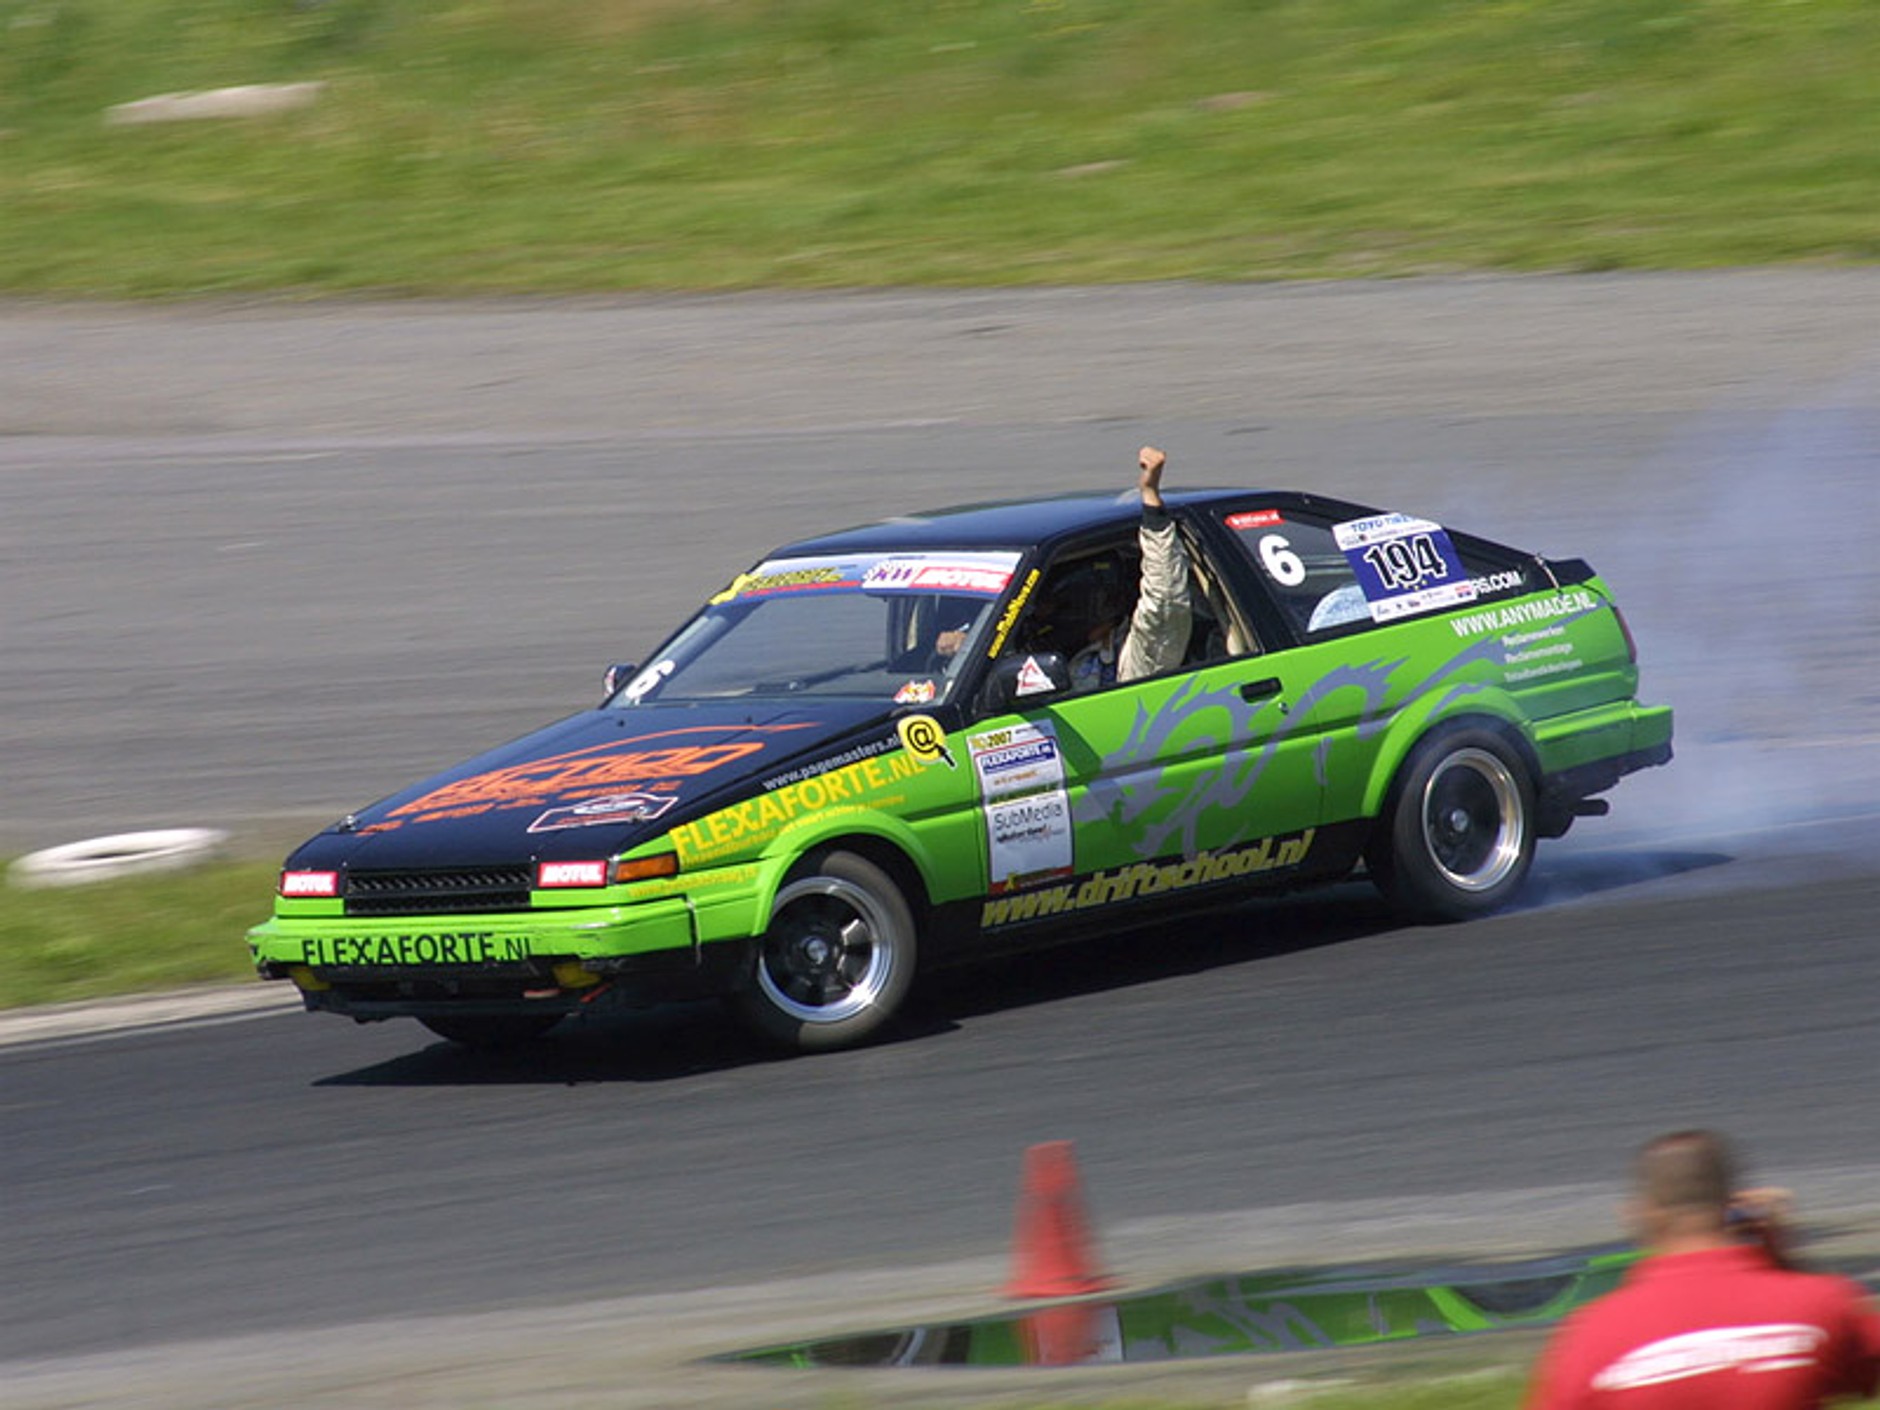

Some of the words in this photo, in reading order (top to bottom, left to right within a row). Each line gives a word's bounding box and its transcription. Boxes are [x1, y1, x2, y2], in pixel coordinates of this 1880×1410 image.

[1259, 534, 1306, 586] 6
[1363, 534, 1447, 589] 194
[1450, 592, 1597, 637] WWW.ANYMADE.NL
[668, 752, 927, 861] FLEXAFORTE.NL
[994, 802, 1063, 831] SubMedia
[283, 873, 335, 892] MOTUL
[540, 864, 603, 883] MOTUL
